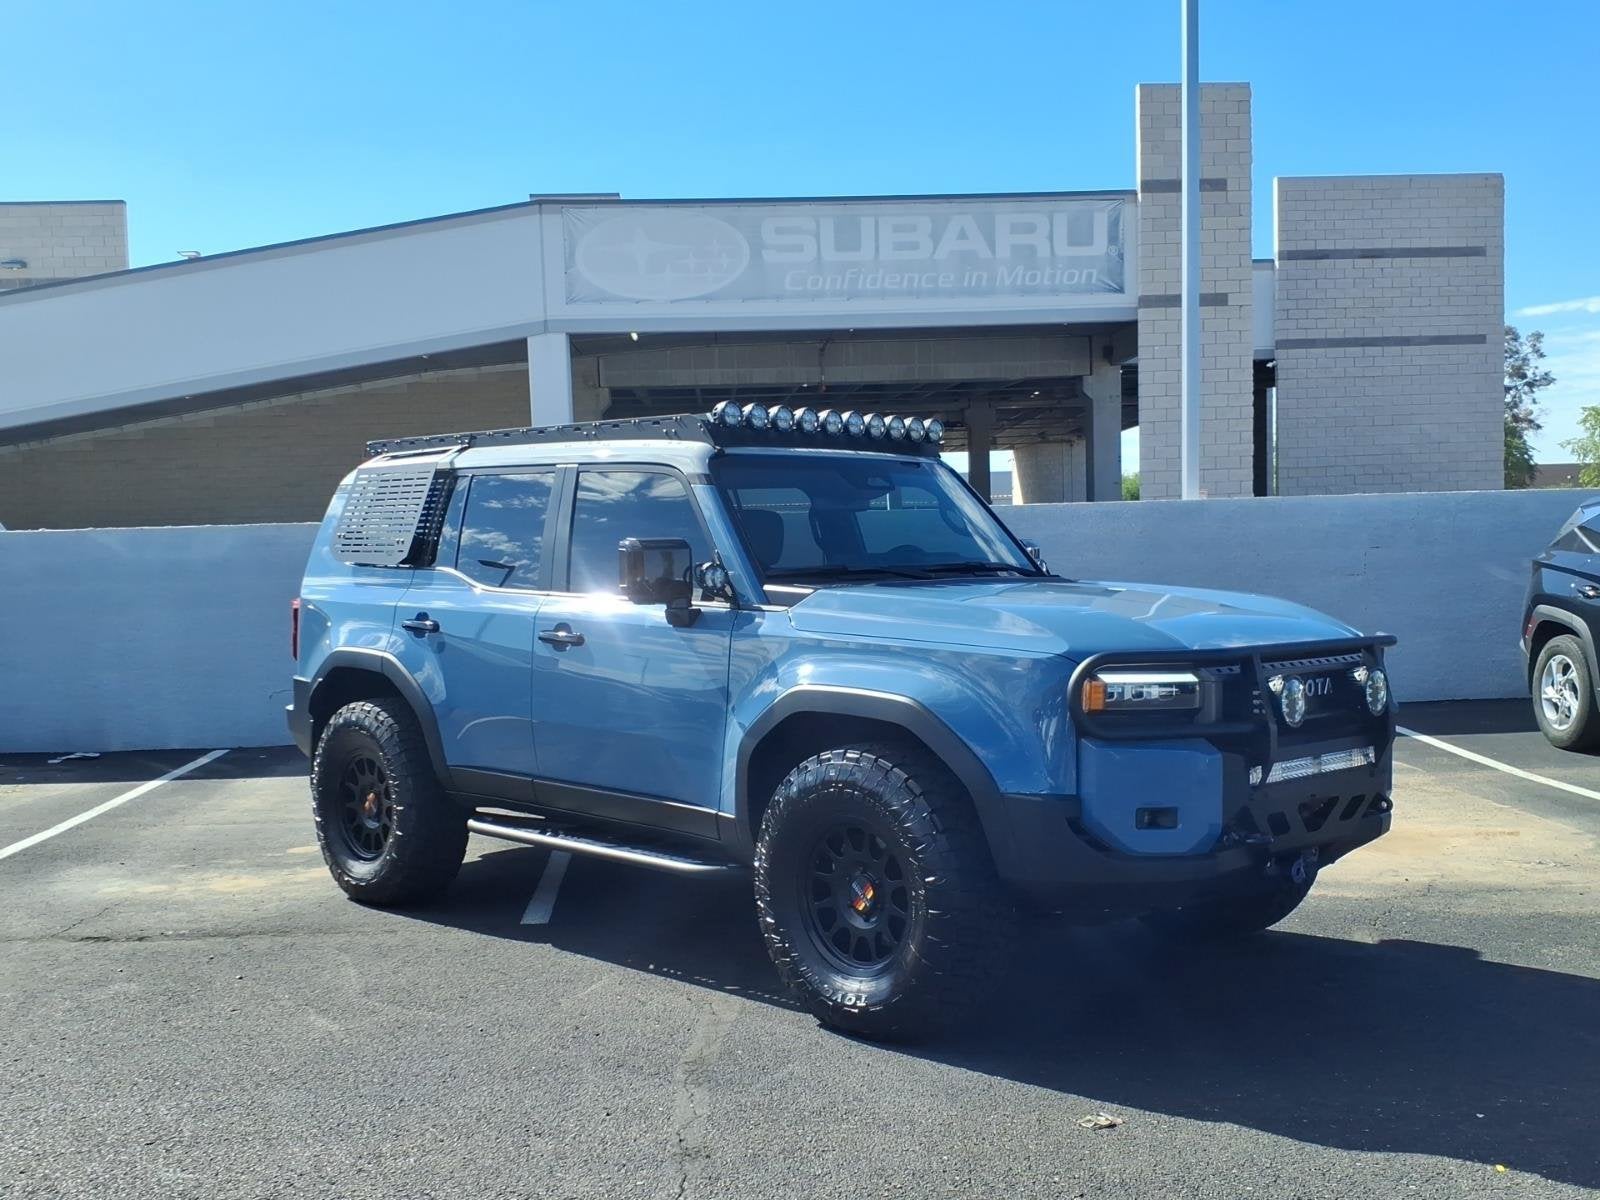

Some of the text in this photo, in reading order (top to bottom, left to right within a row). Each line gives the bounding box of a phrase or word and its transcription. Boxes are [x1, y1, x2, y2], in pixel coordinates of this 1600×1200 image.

[761, 211, 1109, 262] SUBARU
[785, 264, 1097, 290] Confidence in Motion
[1305, 678, 1333, 696] OTA
